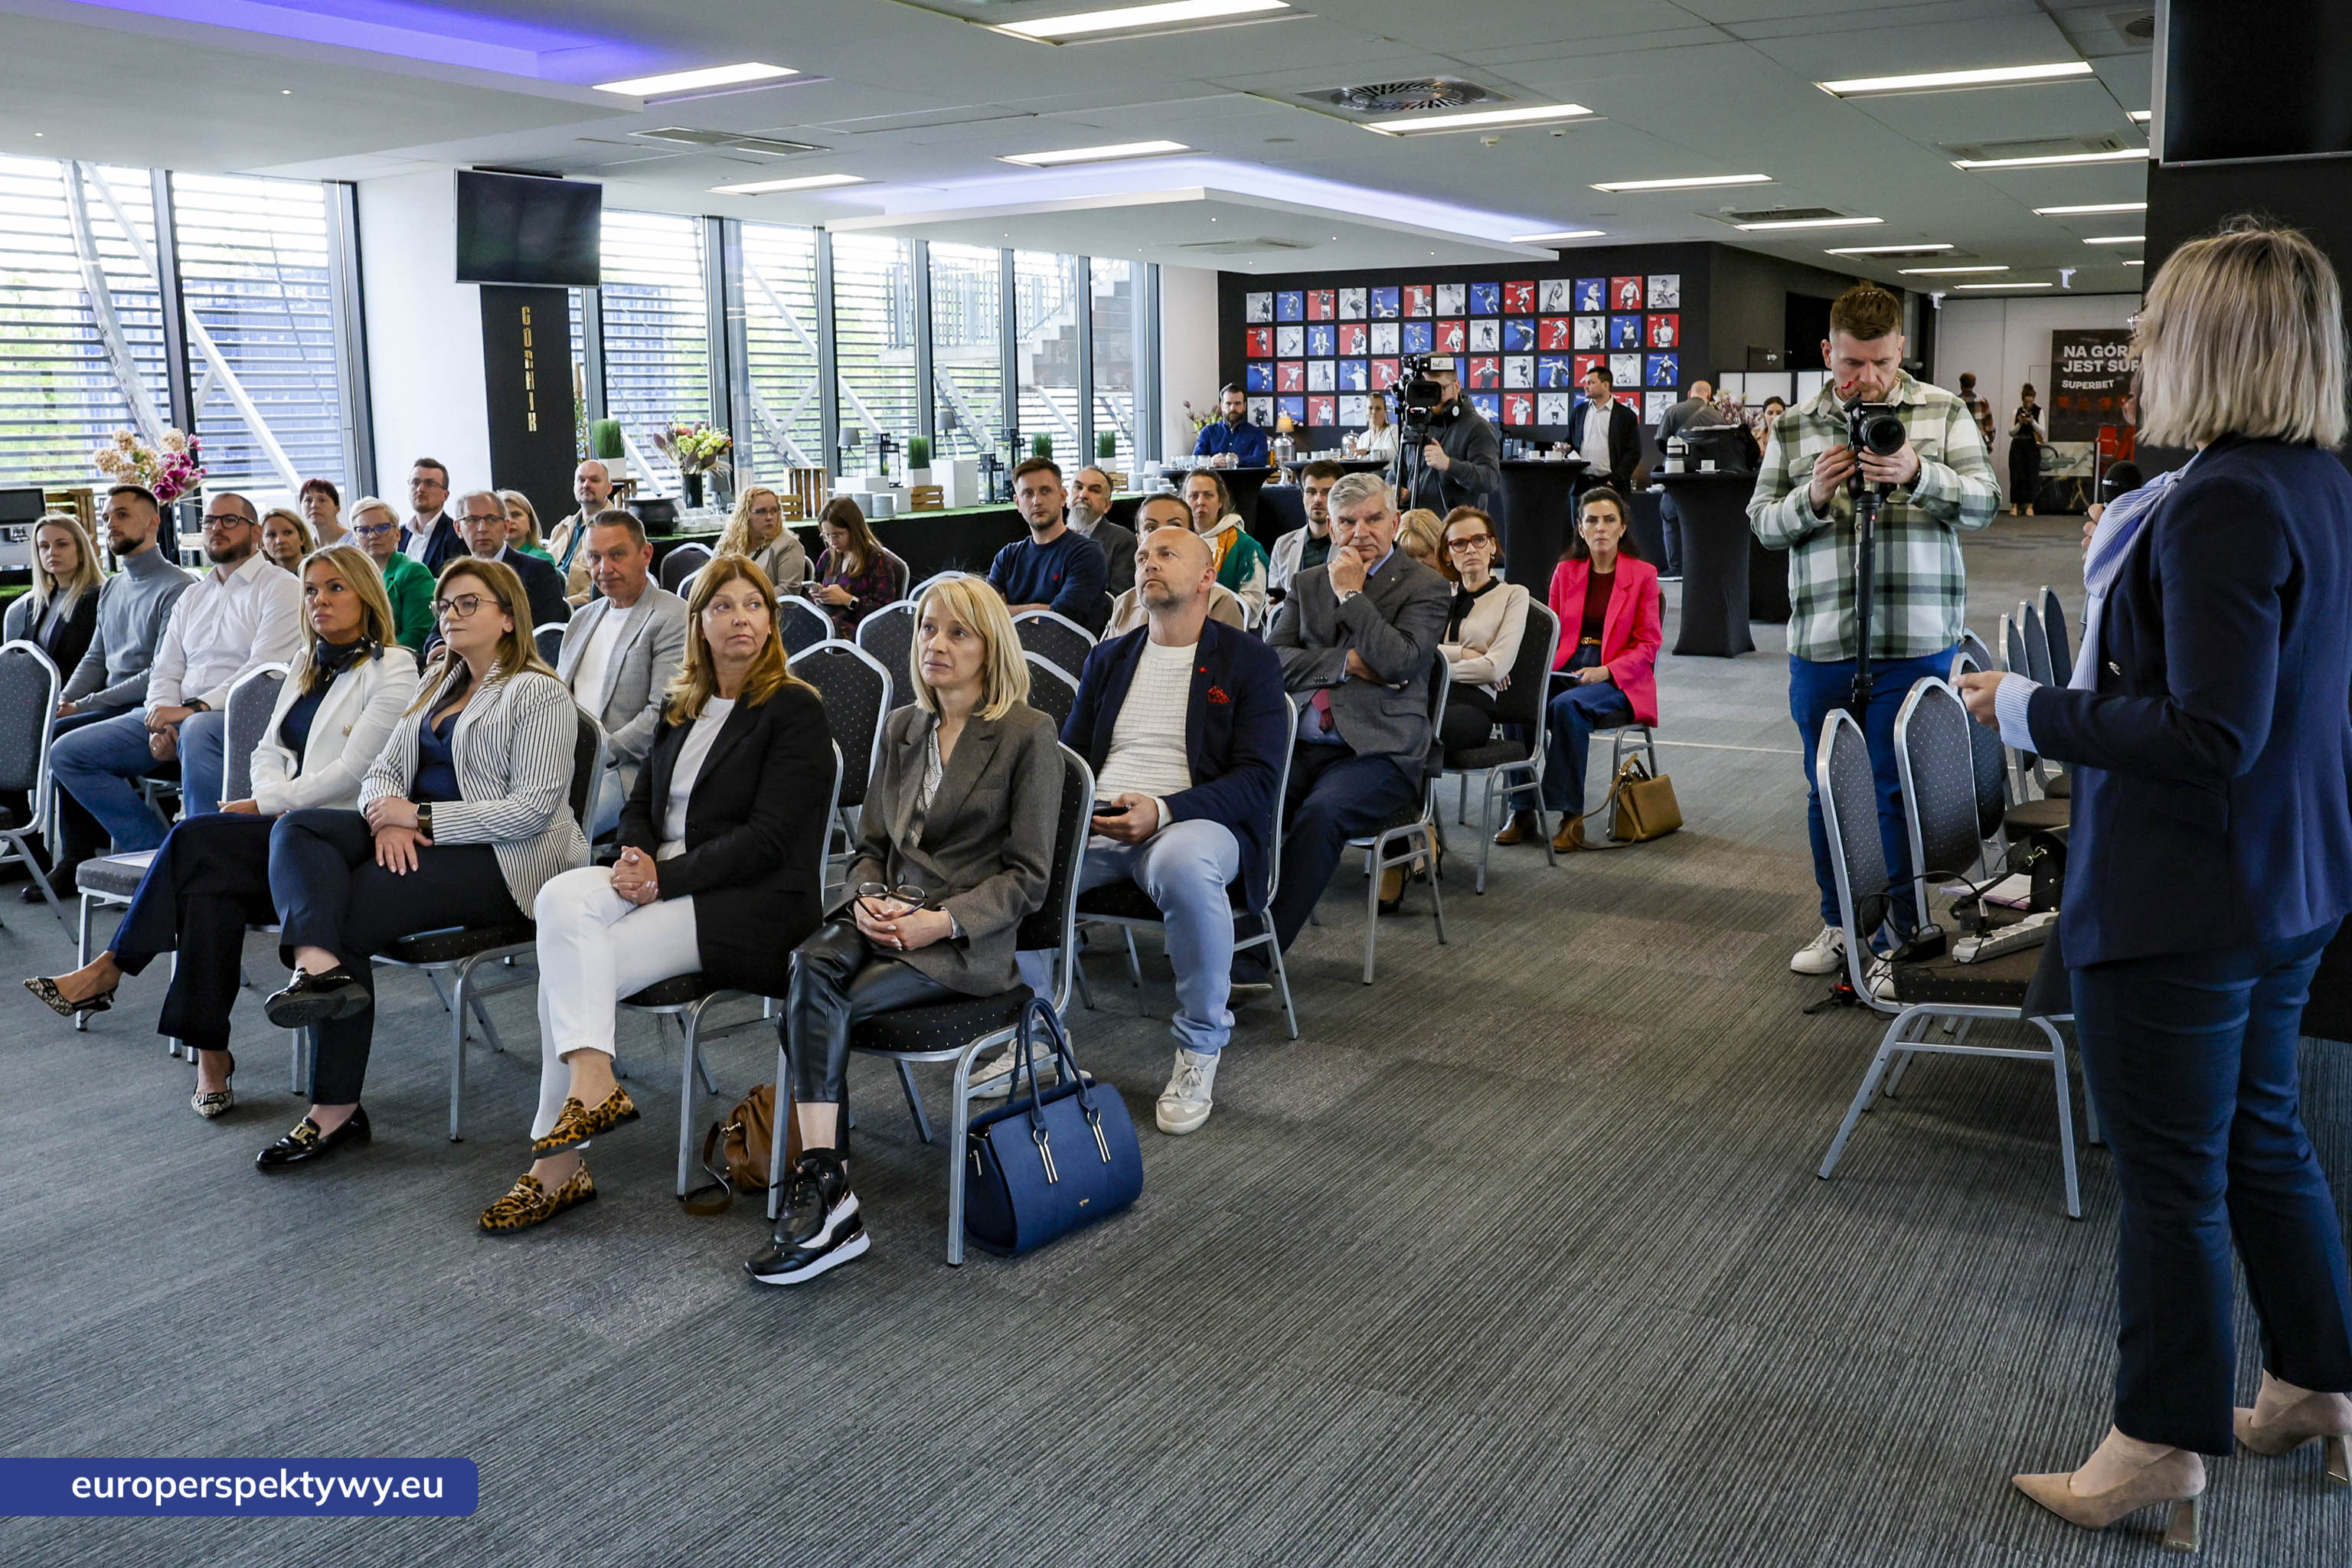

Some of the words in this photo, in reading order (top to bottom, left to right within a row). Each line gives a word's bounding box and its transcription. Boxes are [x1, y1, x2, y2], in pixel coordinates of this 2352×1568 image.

[2063, 345, 2087, 358] NA
[2091, 342, 2132, 358] GÓR
[2063, 360, 2104, 372] JEST
[2061, 380, 2115, 390] SUPERBET
